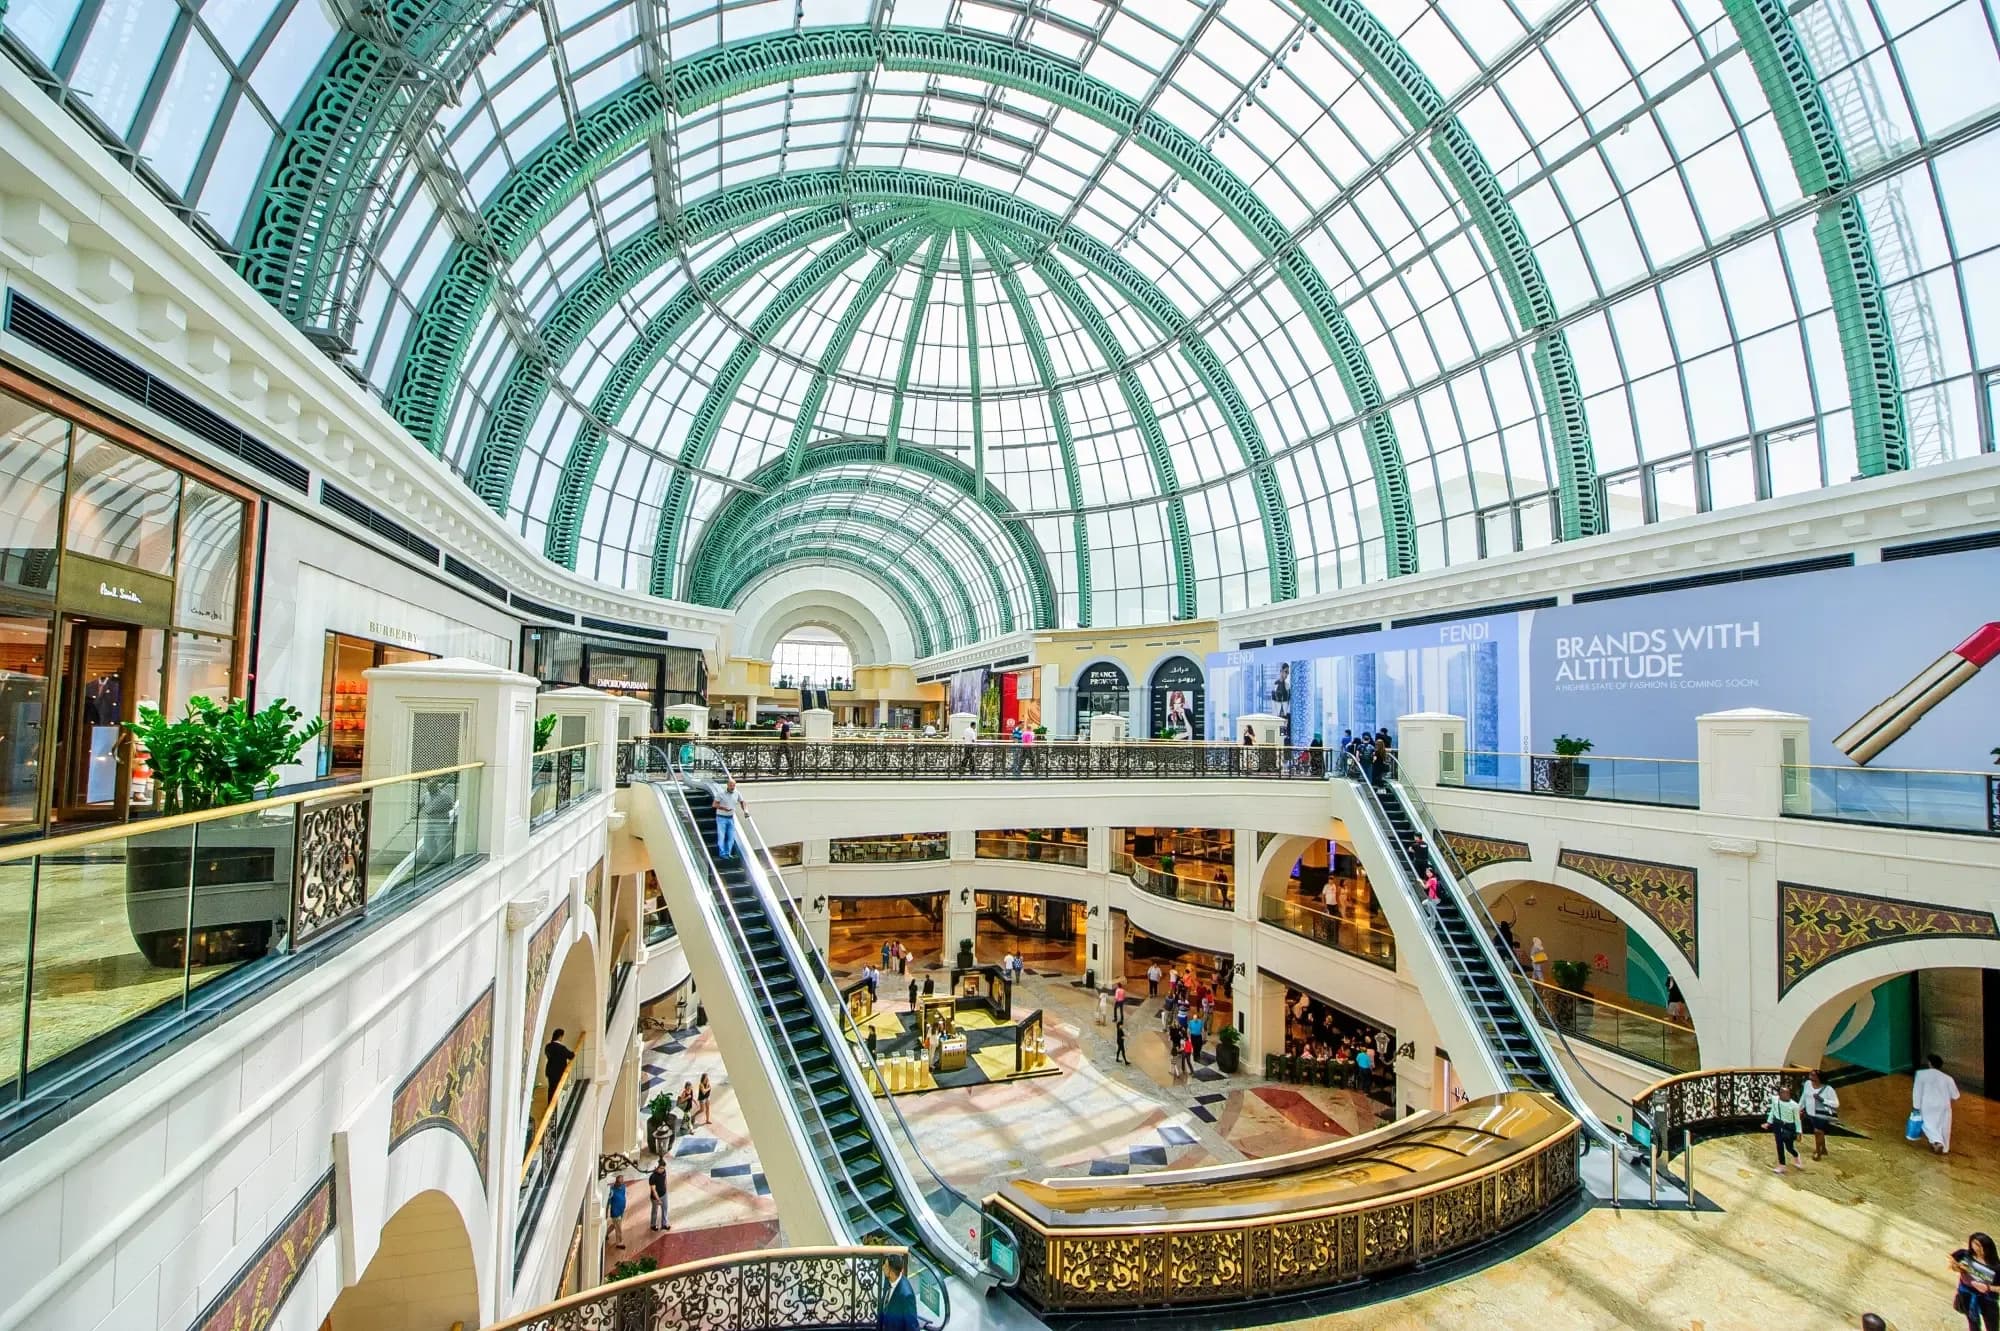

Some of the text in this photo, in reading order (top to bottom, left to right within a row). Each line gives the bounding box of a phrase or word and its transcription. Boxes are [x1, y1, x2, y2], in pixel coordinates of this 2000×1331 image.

[100, 582, 142, 604] Paul Smith
[369, 621, 418, 644] BURBERRY
[1440, 621, 1489, 643] FENDI
[1556, 621, 1760, 659] BRANDS WITH
[1227, 651, 1255, 665] FENDI
[1555, 653, 1684, 682] ALTITUDE
[1591, 682, 1613, 690] STATE
[1615, 681, 1627, 690] OF
[1629, 680, 1668, 689] FASHION
[1669, 680, 1678, 689] IS
[1679, 679, 1721, 689] COMING
